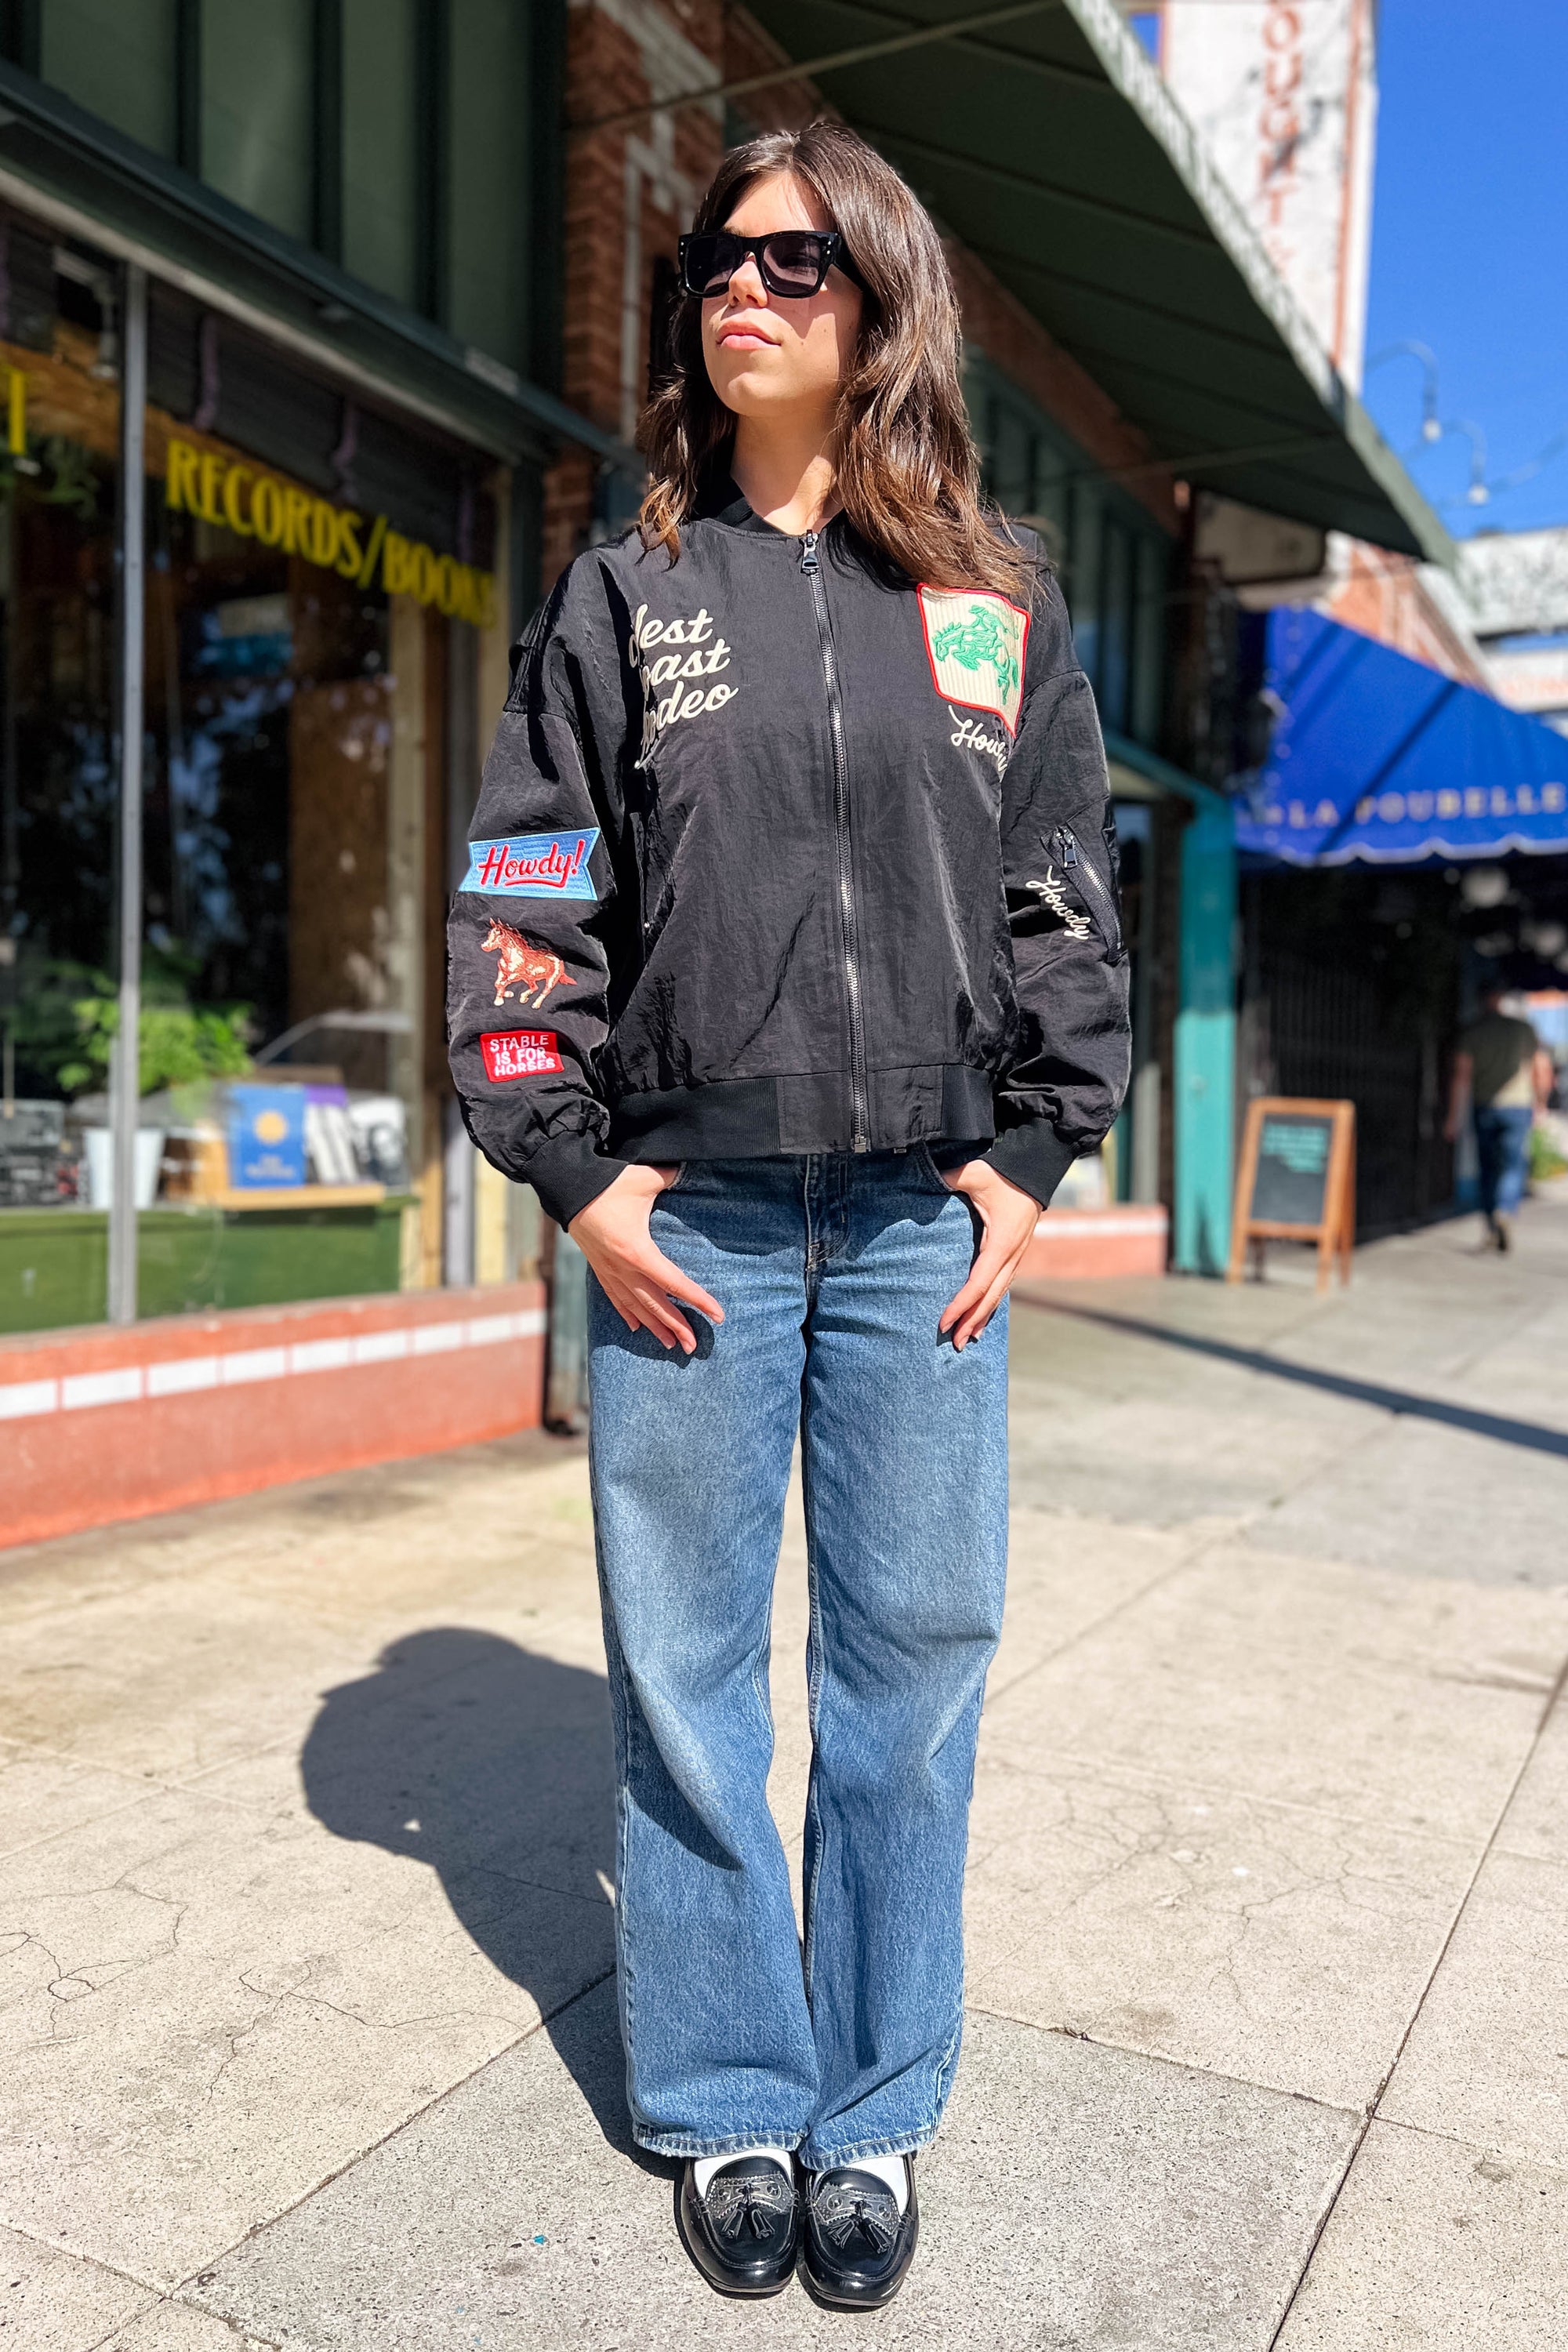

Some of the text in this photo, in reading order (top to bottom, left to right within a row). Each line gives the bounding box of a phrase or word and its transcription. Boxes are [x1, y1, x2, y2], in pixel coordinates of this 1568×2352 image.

[478, 838, 586, 889] Howdy!
[1025, 865, 1091, 940] Howdy
[489, 1034, 550, 1053] STABLE
[495, 1047, 546, 1065] IS FOR
[494, 1057, 556, 1077] HORSES
